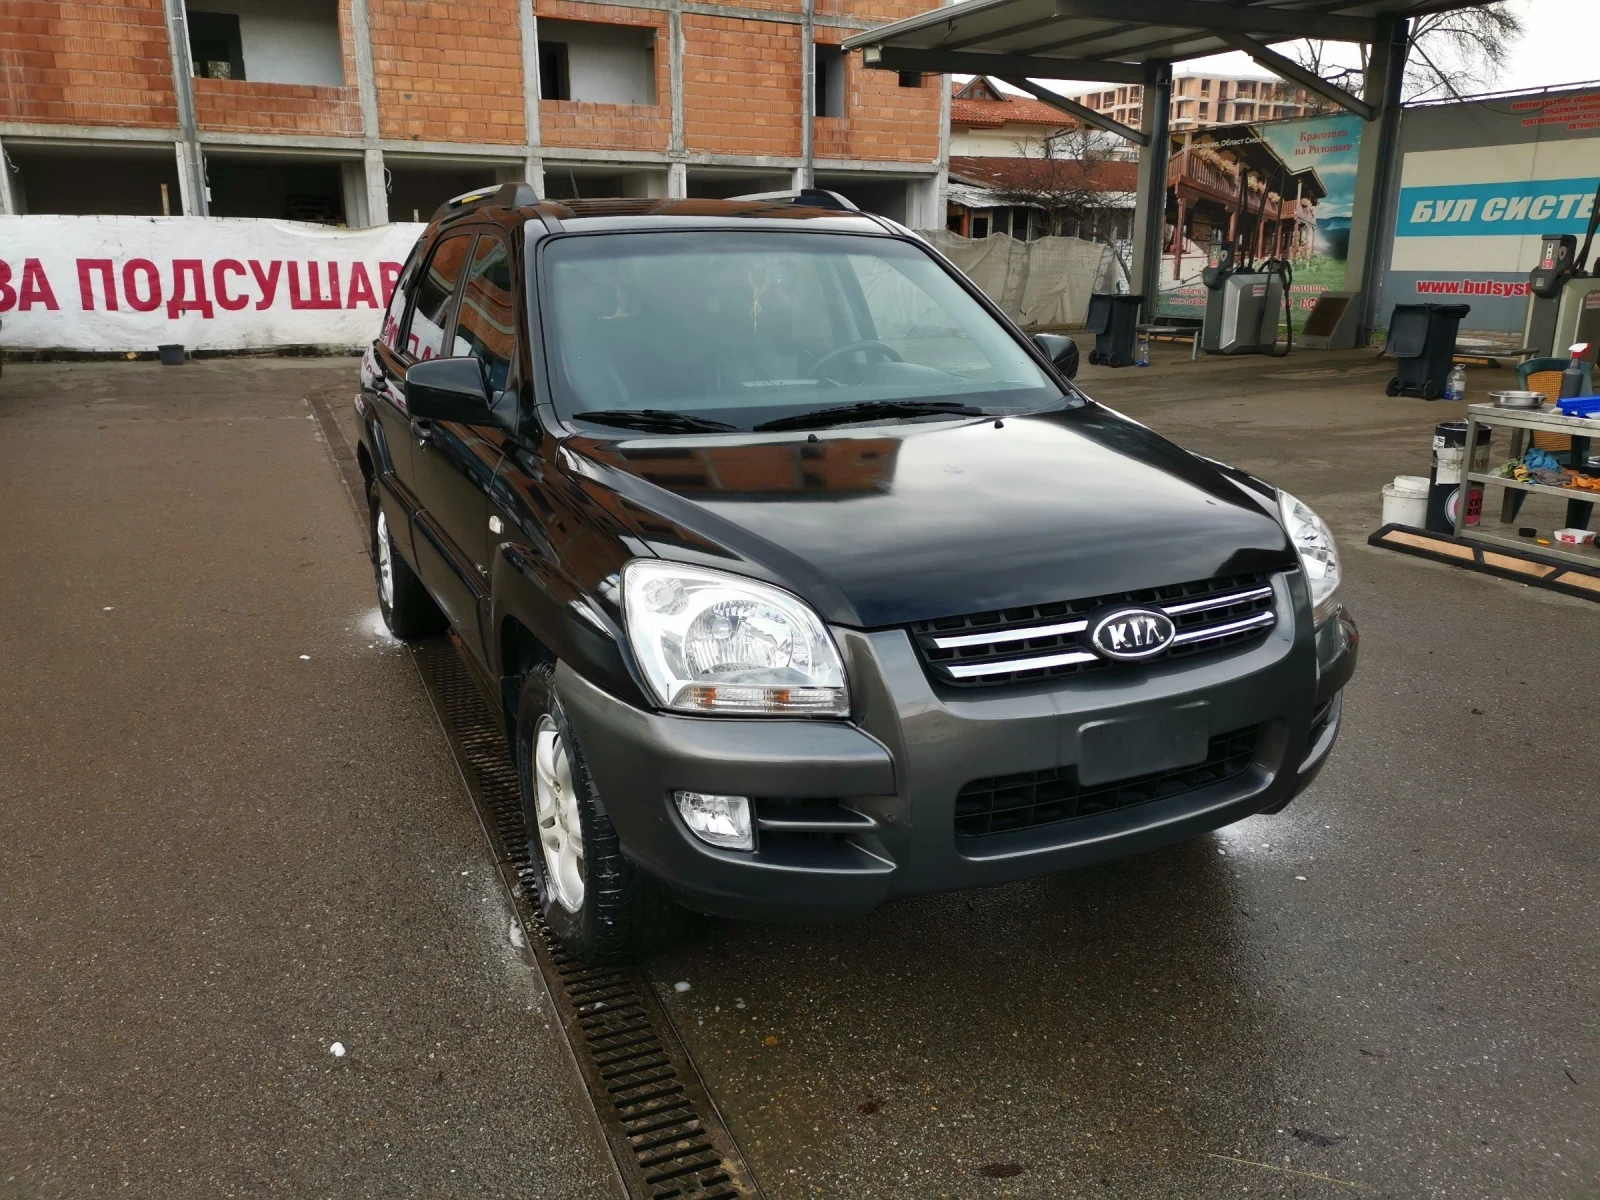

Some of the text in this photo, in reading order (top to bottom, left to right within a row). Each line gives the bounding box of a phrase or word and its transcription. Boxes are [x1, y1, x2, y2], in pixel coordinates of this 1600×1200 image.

[1221, 138, 1244, 147] Област
[1410, 199, 1478, 223] БУЛ
[1108, 618, 1164, 649] KIA
